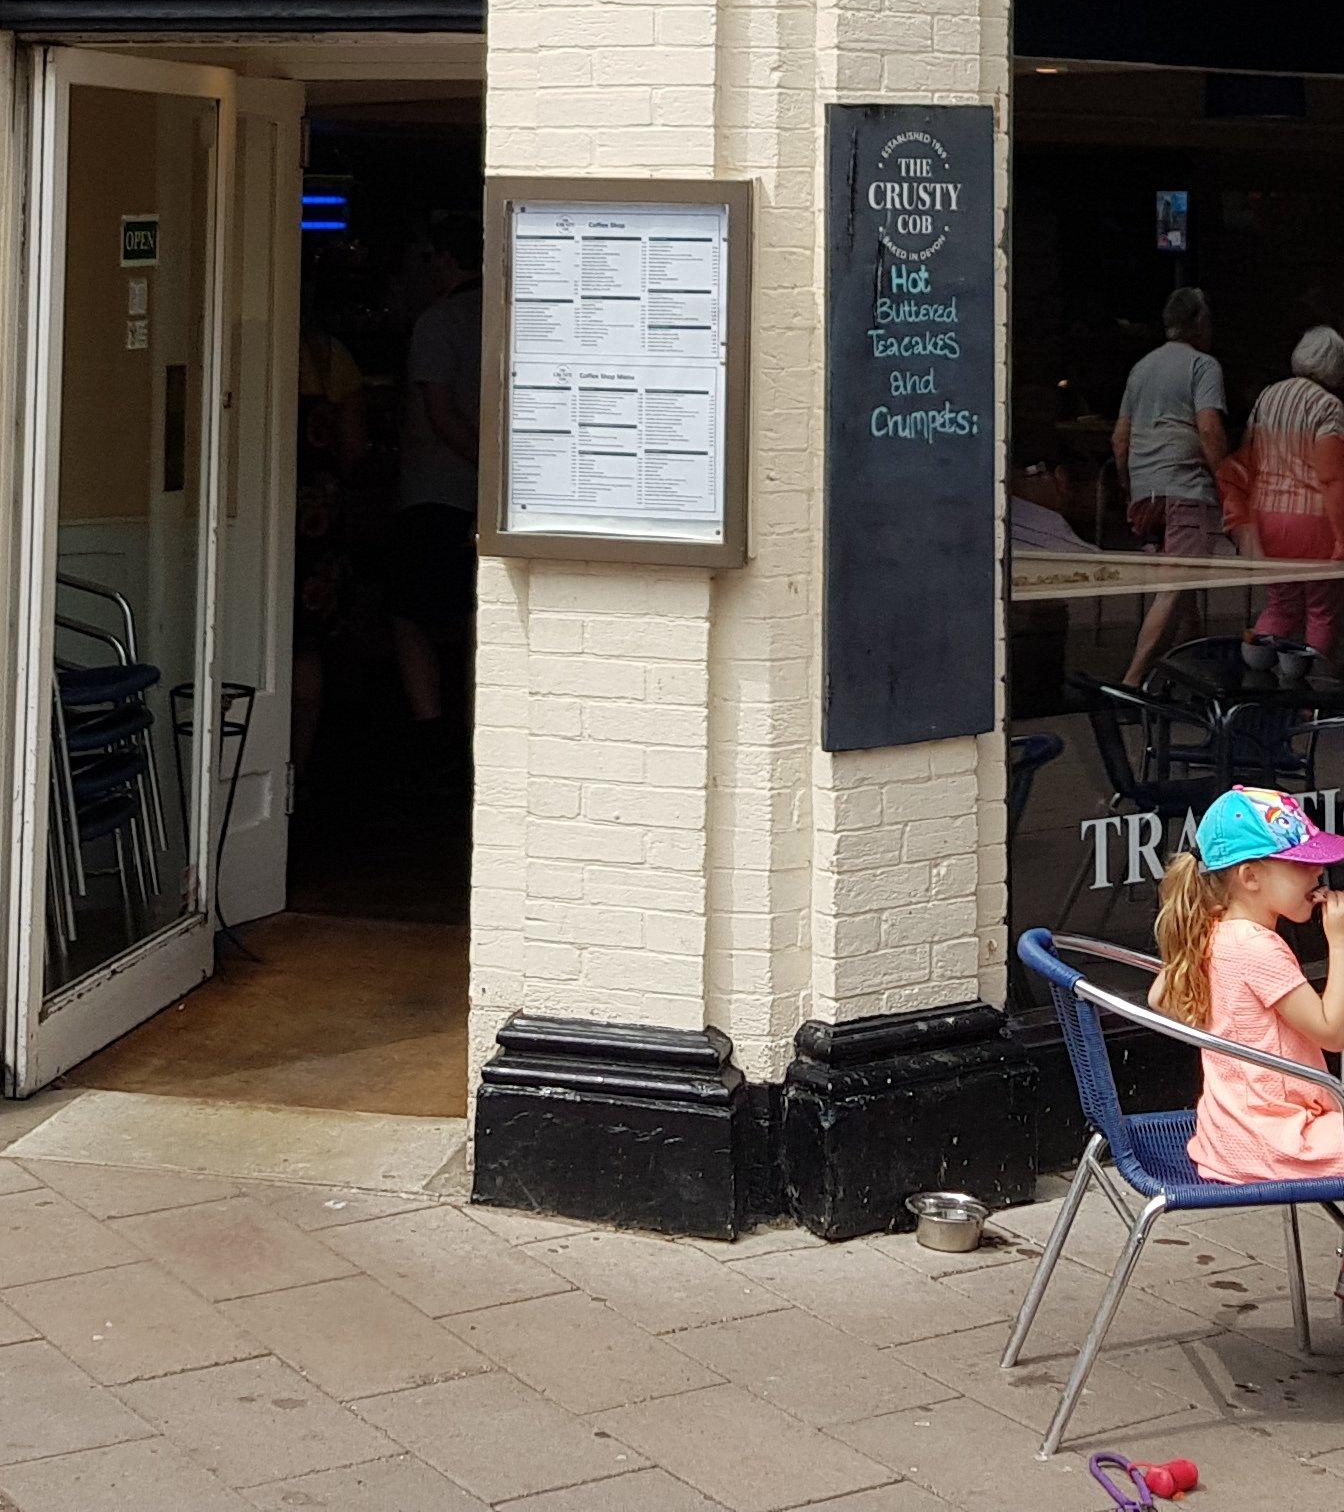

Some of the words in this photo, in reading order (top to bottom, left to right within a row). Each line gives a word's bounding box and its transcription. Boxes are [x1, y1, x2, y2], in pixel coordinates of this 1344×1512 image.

[898, 158, 933, 177] THE
[868, 182, 961, 211] CRUSTY
[897, 214, 933, 234] COB
[125, 231, 154, 250] OPEN
[908, 252, 918, 261] IN
[891, 265, 931, 295] Hot
[876, 298, 958, 324] Buttered
